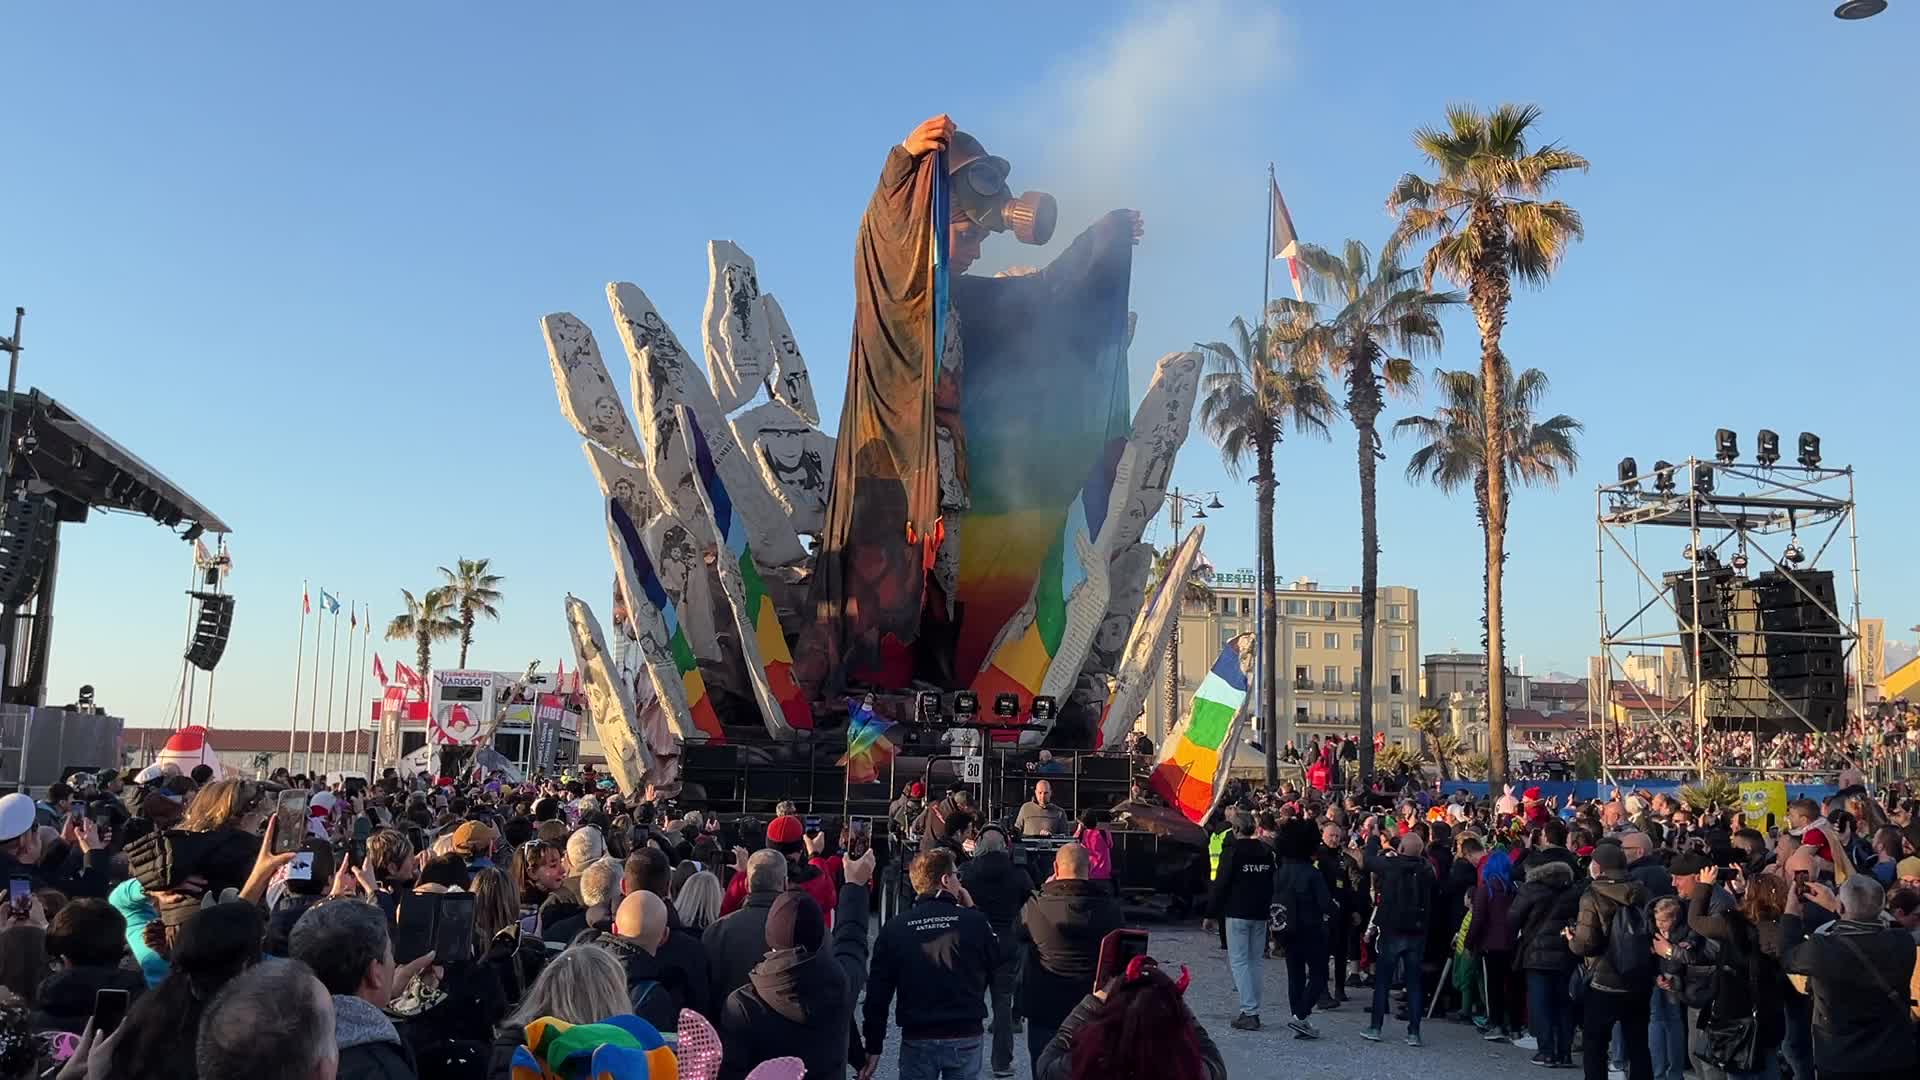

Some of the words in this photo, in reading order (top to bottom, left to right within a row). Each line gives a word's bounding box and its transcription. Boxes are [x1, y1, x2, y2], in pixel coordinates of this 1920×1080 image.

[1209, 572, 1284, 585] PRESIDT
[967, 763, 980, 777] 30
[1242, 864, 1270, 873] STAFF
